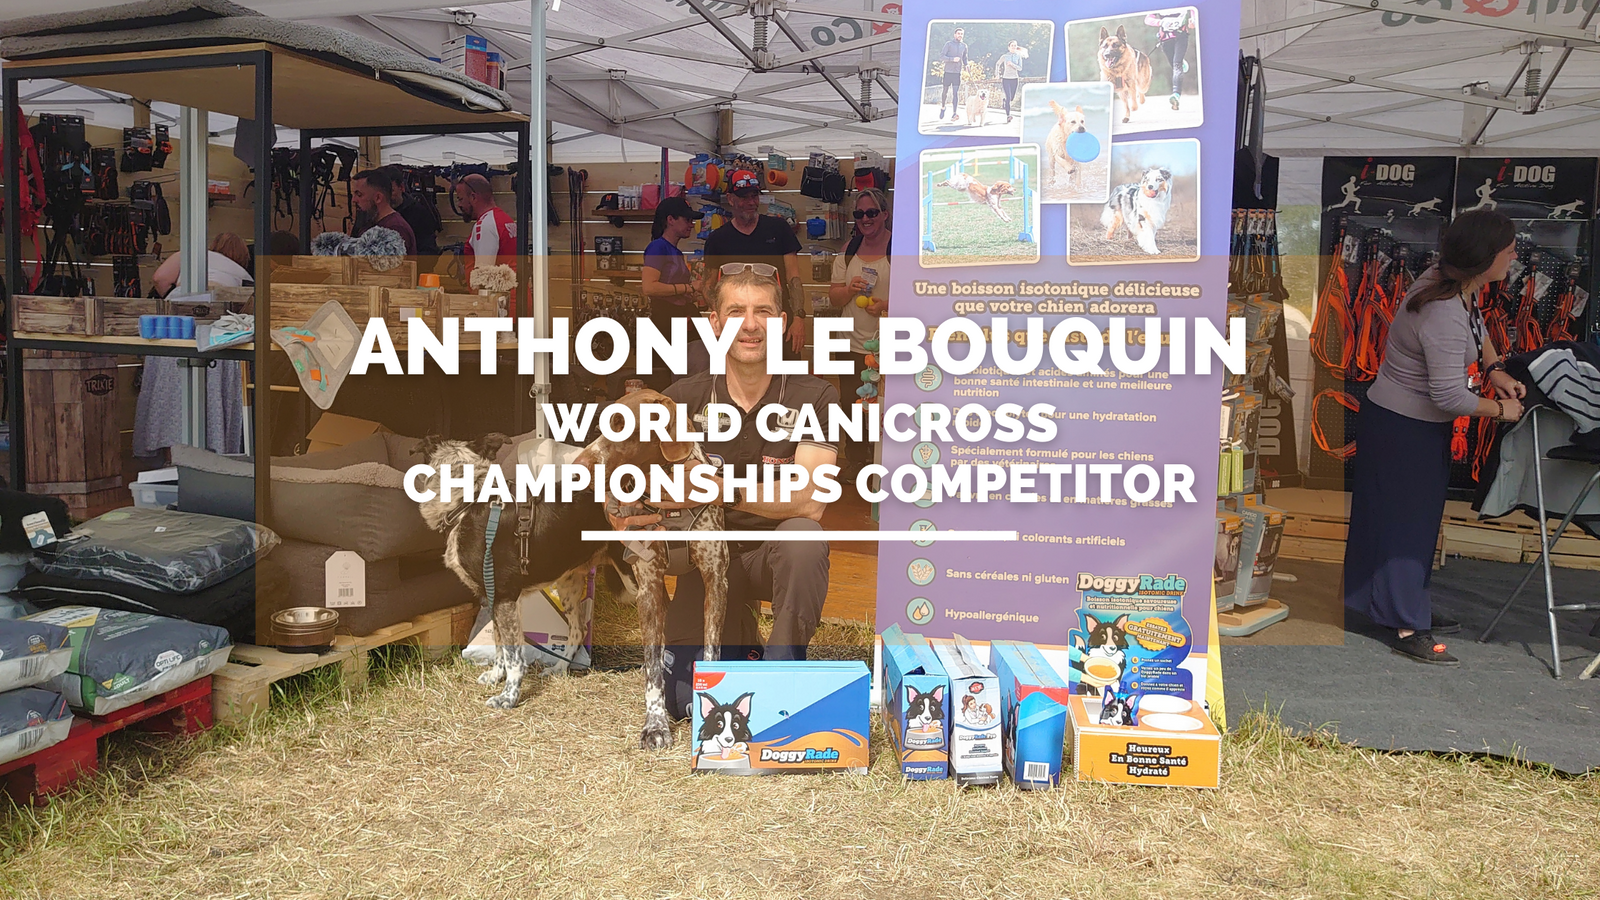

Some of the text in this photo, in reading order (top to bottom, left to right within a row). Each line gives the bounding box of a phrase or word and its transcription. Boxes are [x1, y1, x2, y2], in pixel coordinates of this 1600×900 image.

[915, 282, 1200, 299] Une boisson isotonique délicieuse
[954, 300, 1155, 315] que votre chien adorera
[1147, 371, 1169, 379] une
[86, 379, 113, 391] TRIXIE
[953, 376, 1173, 391] bonne santé intestinale et une meilleure
[953, 387, 1000, 398] nutrition
[1068, 411, 1090, 420] une
[1092, 411, 1157, 422] hydratation
[951, 445, 1155, 462] Spécialement formulé pour les chiens
[1022, 533, 1073, 545] colorants
[1075, 535, 1126, 547] artificiels
[946, 568, 1070, 585] Sans céréales ni gluten
[1078, 574, 1186, 593] DoggyRade
[1111, 596, 1143, 605] isotonique
[945, 608, 1040, 624] Hypoallergénique
[1128, 624, 1182, 645] GRATUITEMENT
[907, 736, 942, 745] DoggyRade
[761, 747, 839, 763] DoggyRade
[1128, 744, 1170, 754] Heureux
[1111, 754, 1187, 766] En Bonne Santé
[905, 766, 944, 774] DoggyRade
[1129, 766, 1168, 776] Hydraté
